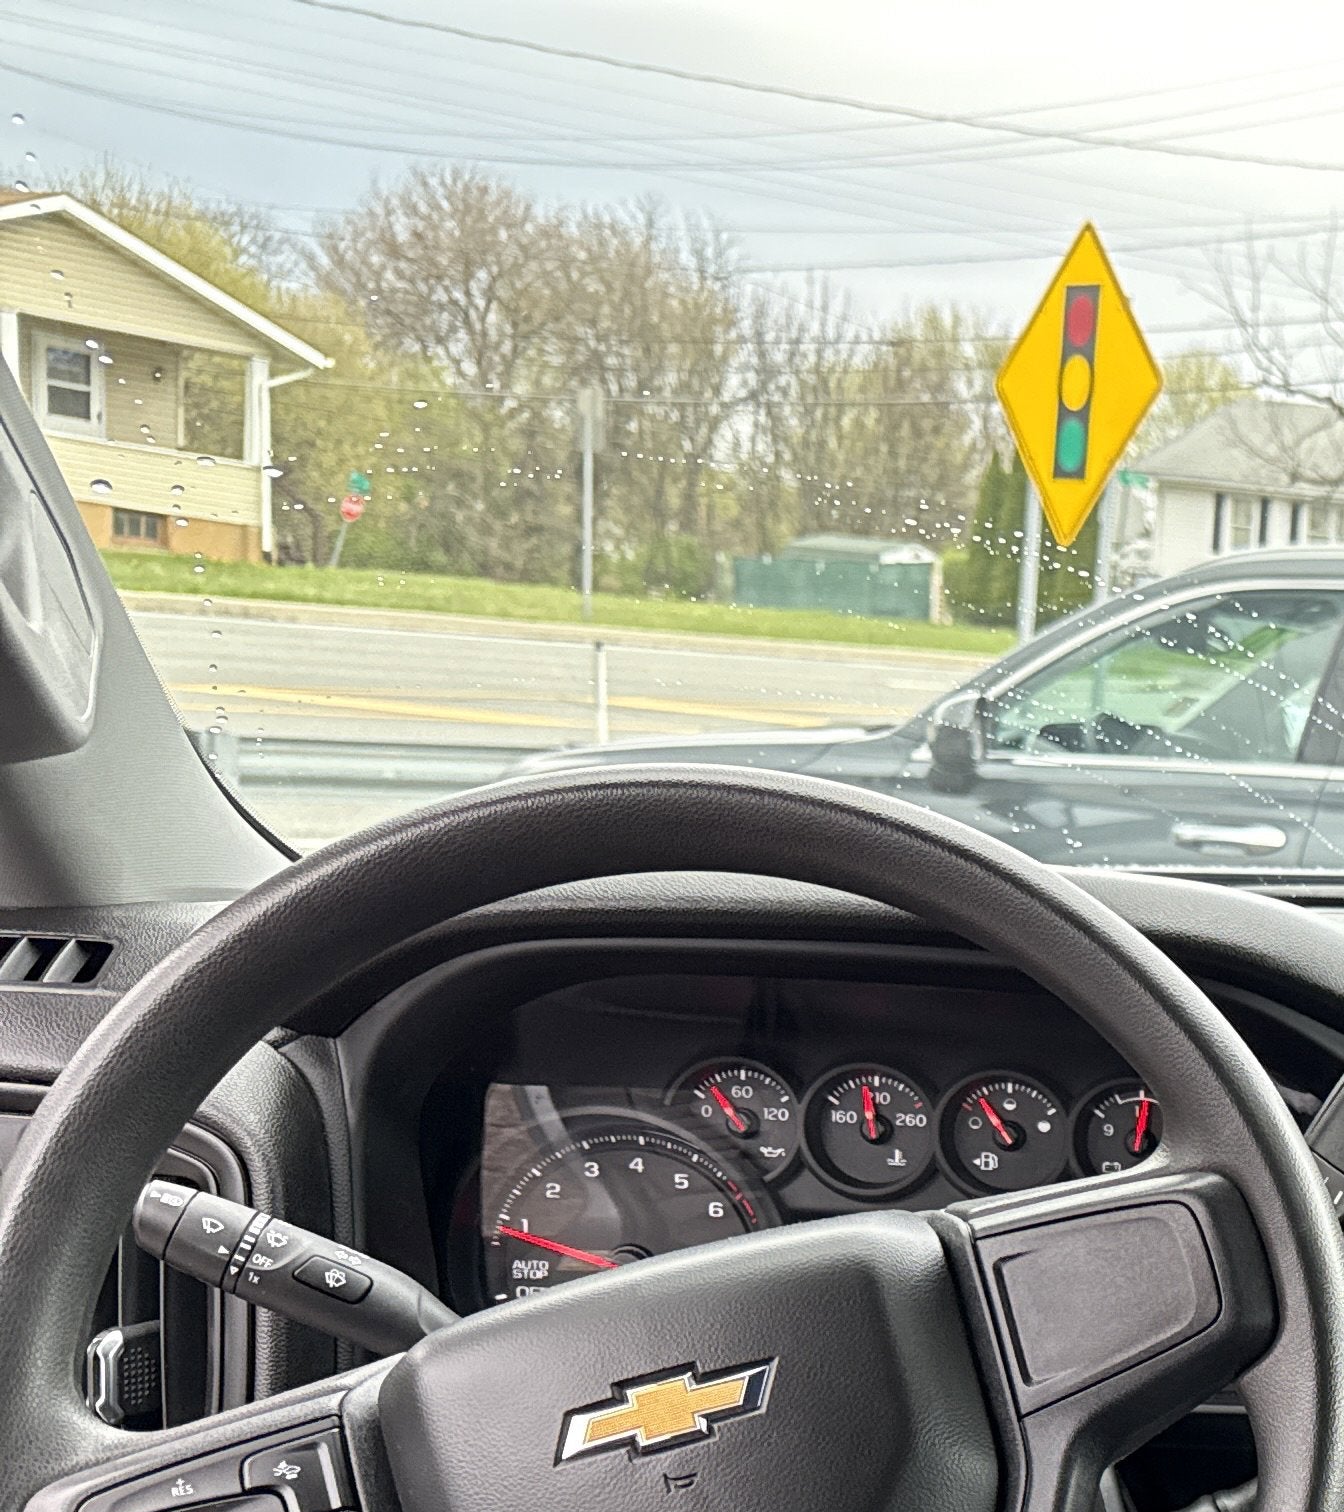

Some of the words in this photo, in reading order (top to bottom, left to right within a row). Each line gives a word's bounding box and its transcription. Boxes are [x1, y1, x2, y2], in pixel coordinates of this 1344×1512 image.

[731, 1085, 754, 1099] 60
[868, 1091, 891, 1105] 10
[701, 1105, 713, 1118] 0
[763, 1107, 790, 1121] 120
[831, 1109, 858, 1124] 160
[895, 1112, 927, 1128] 260
[1103, 1123, 1115, 1137] 9
[583, 1162, 600, 1178] 3
[628, 1157, 645, 1173] 4
[674, 1174, 689, 1190] 5
[545, 1182, 561, 1199] 2
[708, 1201, 724, 1218] 6
[520, 1219, 529, 1233] 1
[252, 1253, 274, 1268] OFF
[512, 1259, 549, 1270] AUTO
[512, 1269, 549, 1280] STOP
[171, 1484, 194, 1497] RES
